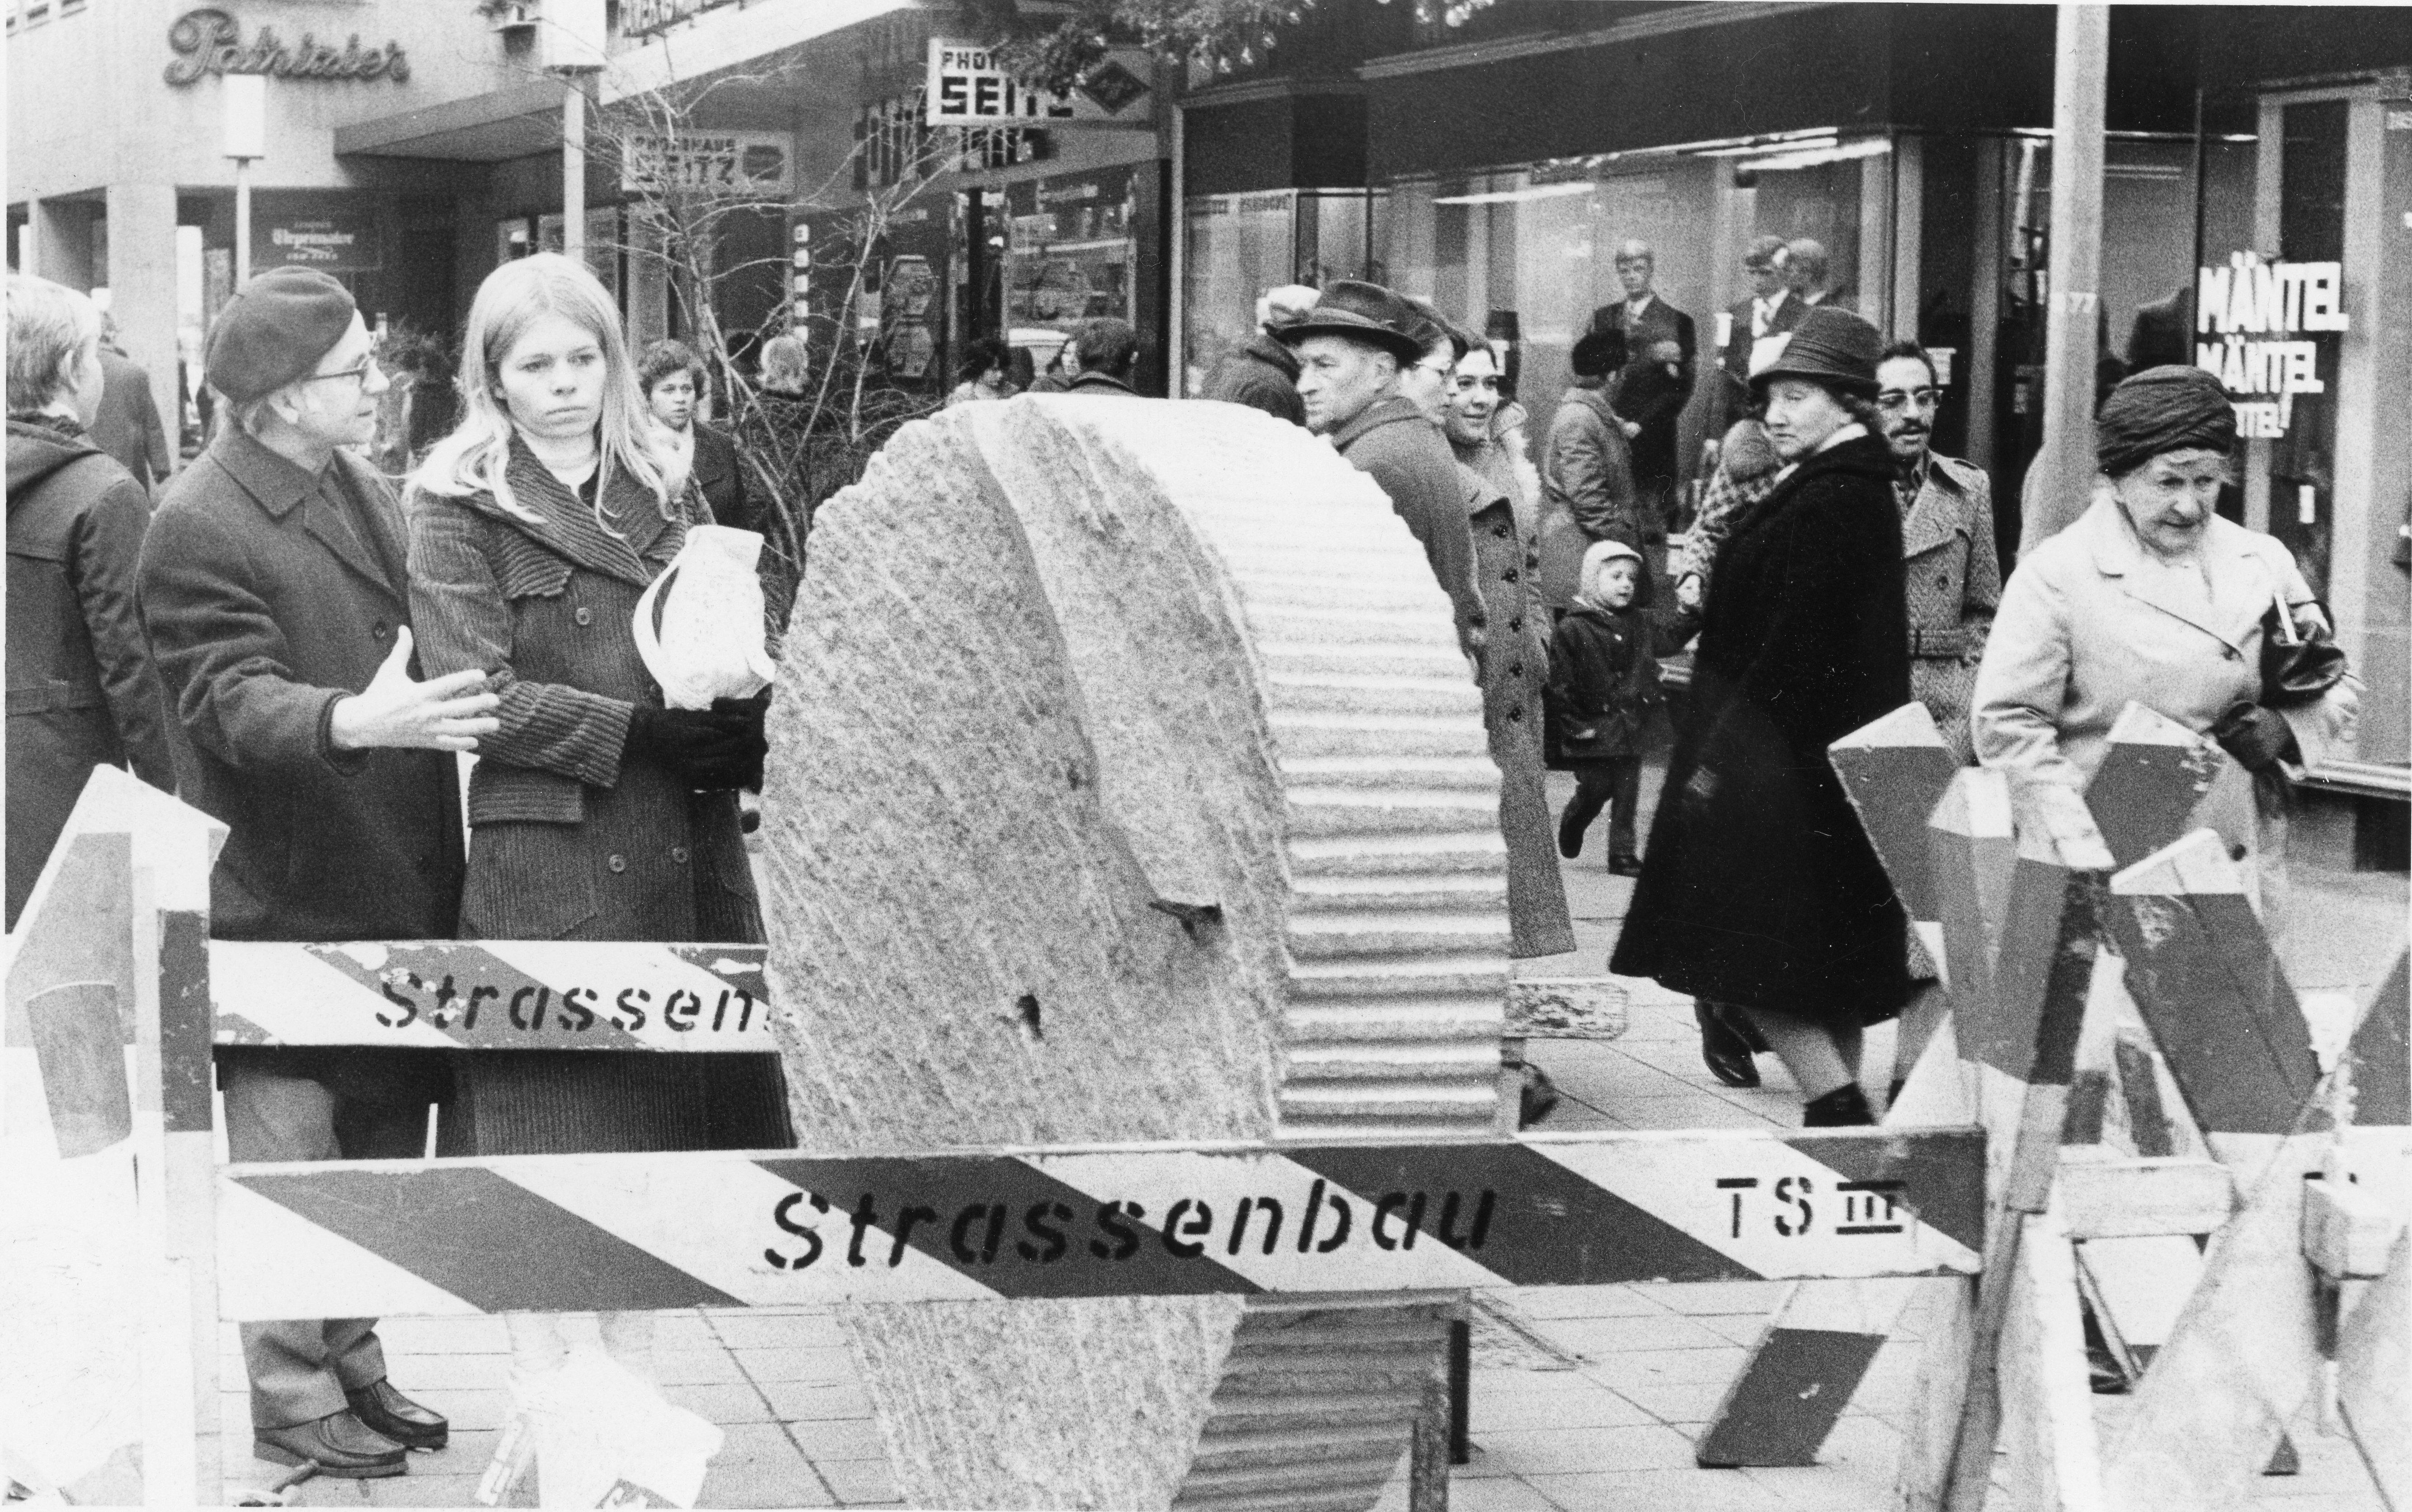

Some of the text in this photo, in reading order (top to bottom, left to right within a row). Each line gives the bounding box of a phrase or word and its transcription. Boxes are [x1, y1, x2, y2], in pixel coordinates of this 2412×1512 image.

[942, 51, 998, 71] PHOT
[2197, 250, 2350, 333] MÄNTEL
[376, 971, 770, 1032] Strassen
[764, 1178, 1495, 1271] Strassenbau
[1716, 1176, 1813, 1239] TS
